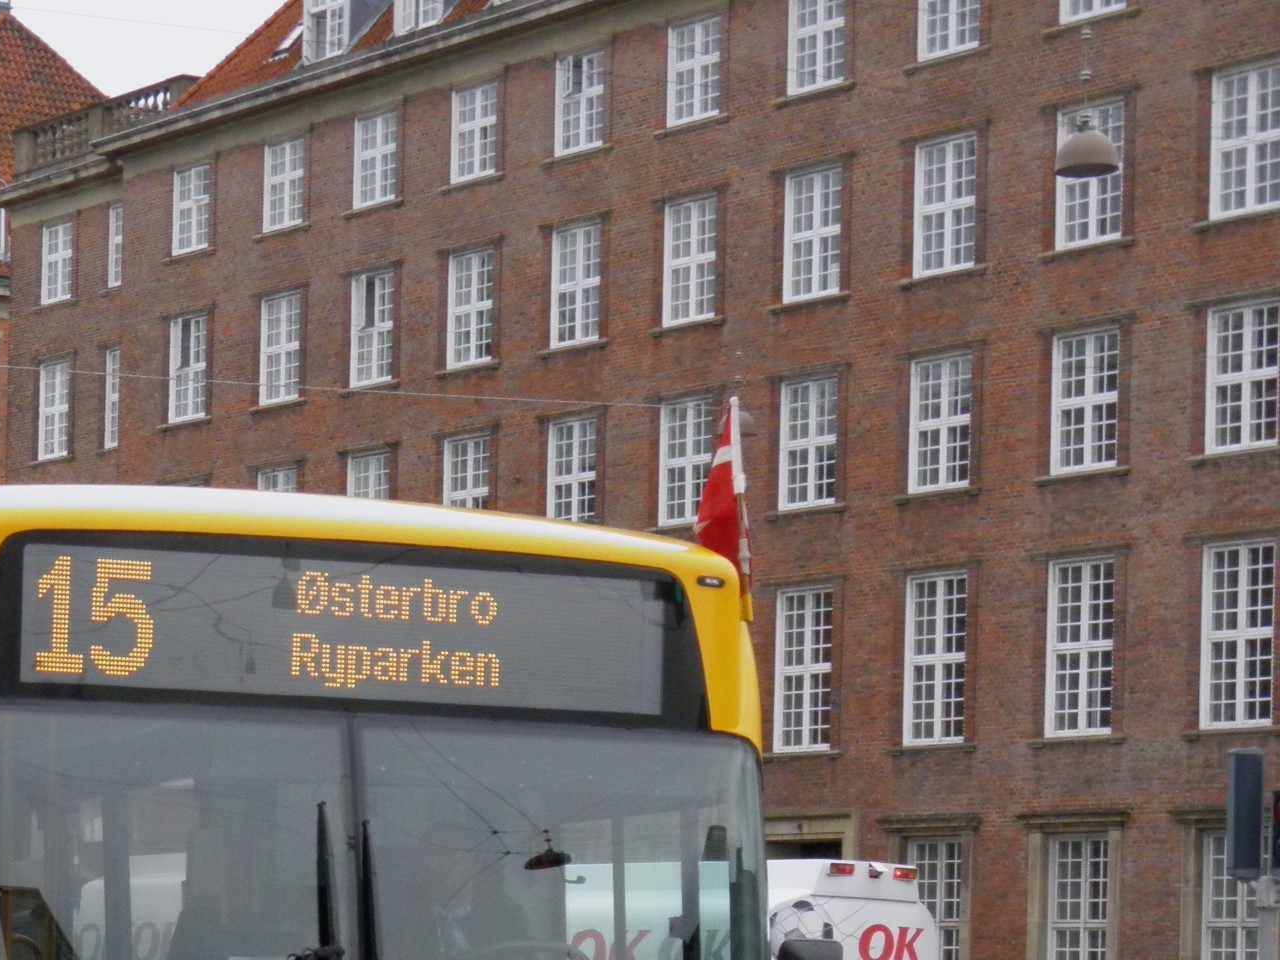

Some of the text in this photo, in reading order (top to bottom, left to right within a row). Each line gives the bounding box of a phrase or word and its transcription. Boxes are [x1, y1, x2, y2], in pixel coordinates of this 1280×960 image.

[34, 555, 156, 676] 15
[295, 570, 499, 626] Østerbro
[290, 632, 500, 688] Ryparken
